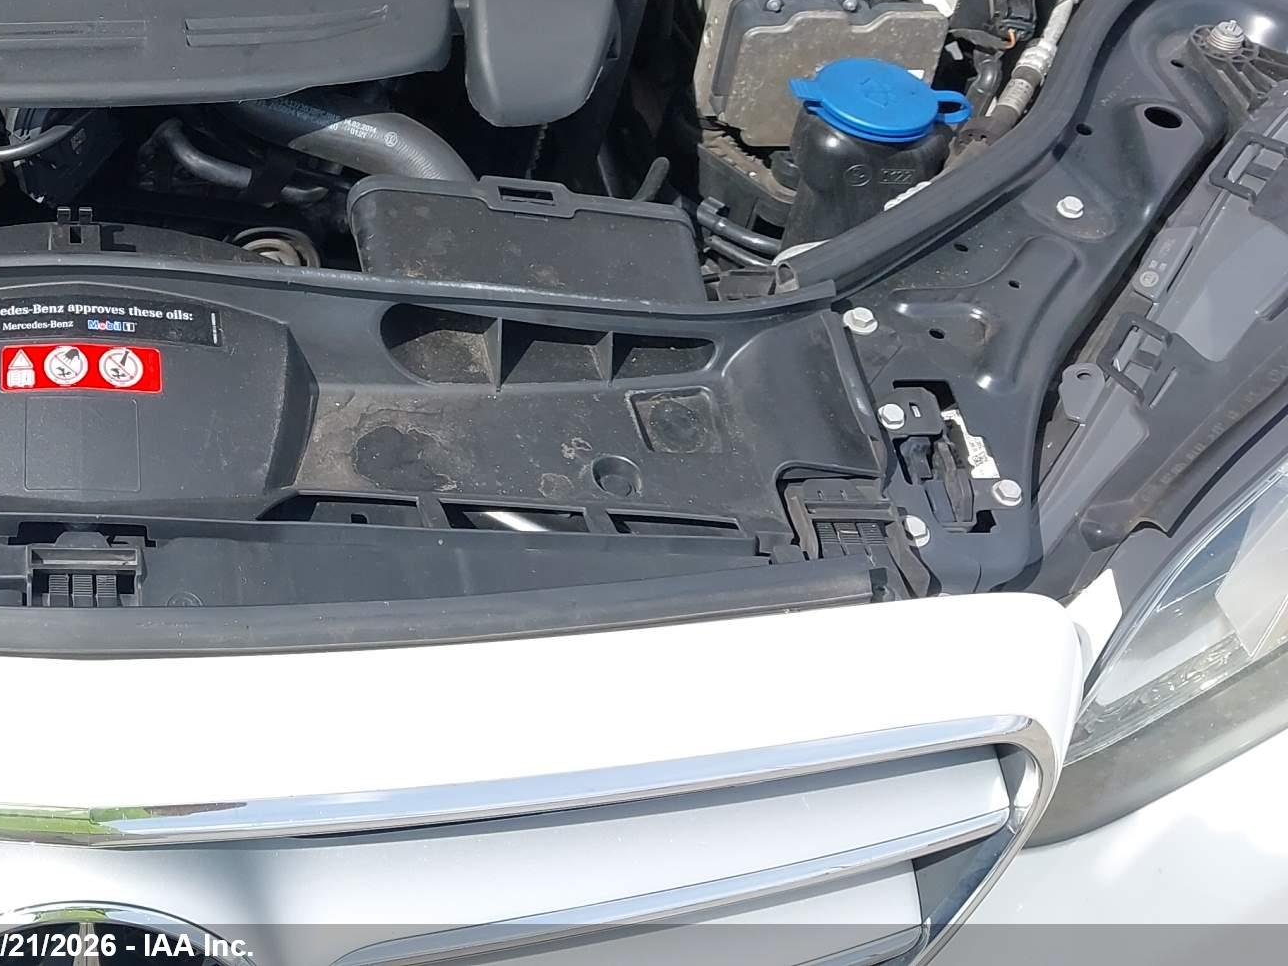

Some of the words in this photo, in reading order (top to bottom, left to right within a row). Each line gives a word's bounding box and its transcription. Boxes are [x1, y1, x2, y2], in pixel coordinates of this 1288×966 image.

[67, 303, 126, 315] approves
[128, 306, 164, 318] these
[165, 309, 194, 321] oils:
[2, 320, 75, 331] Mercedes-Benz
[87, 319, 122, 331] Mobil
